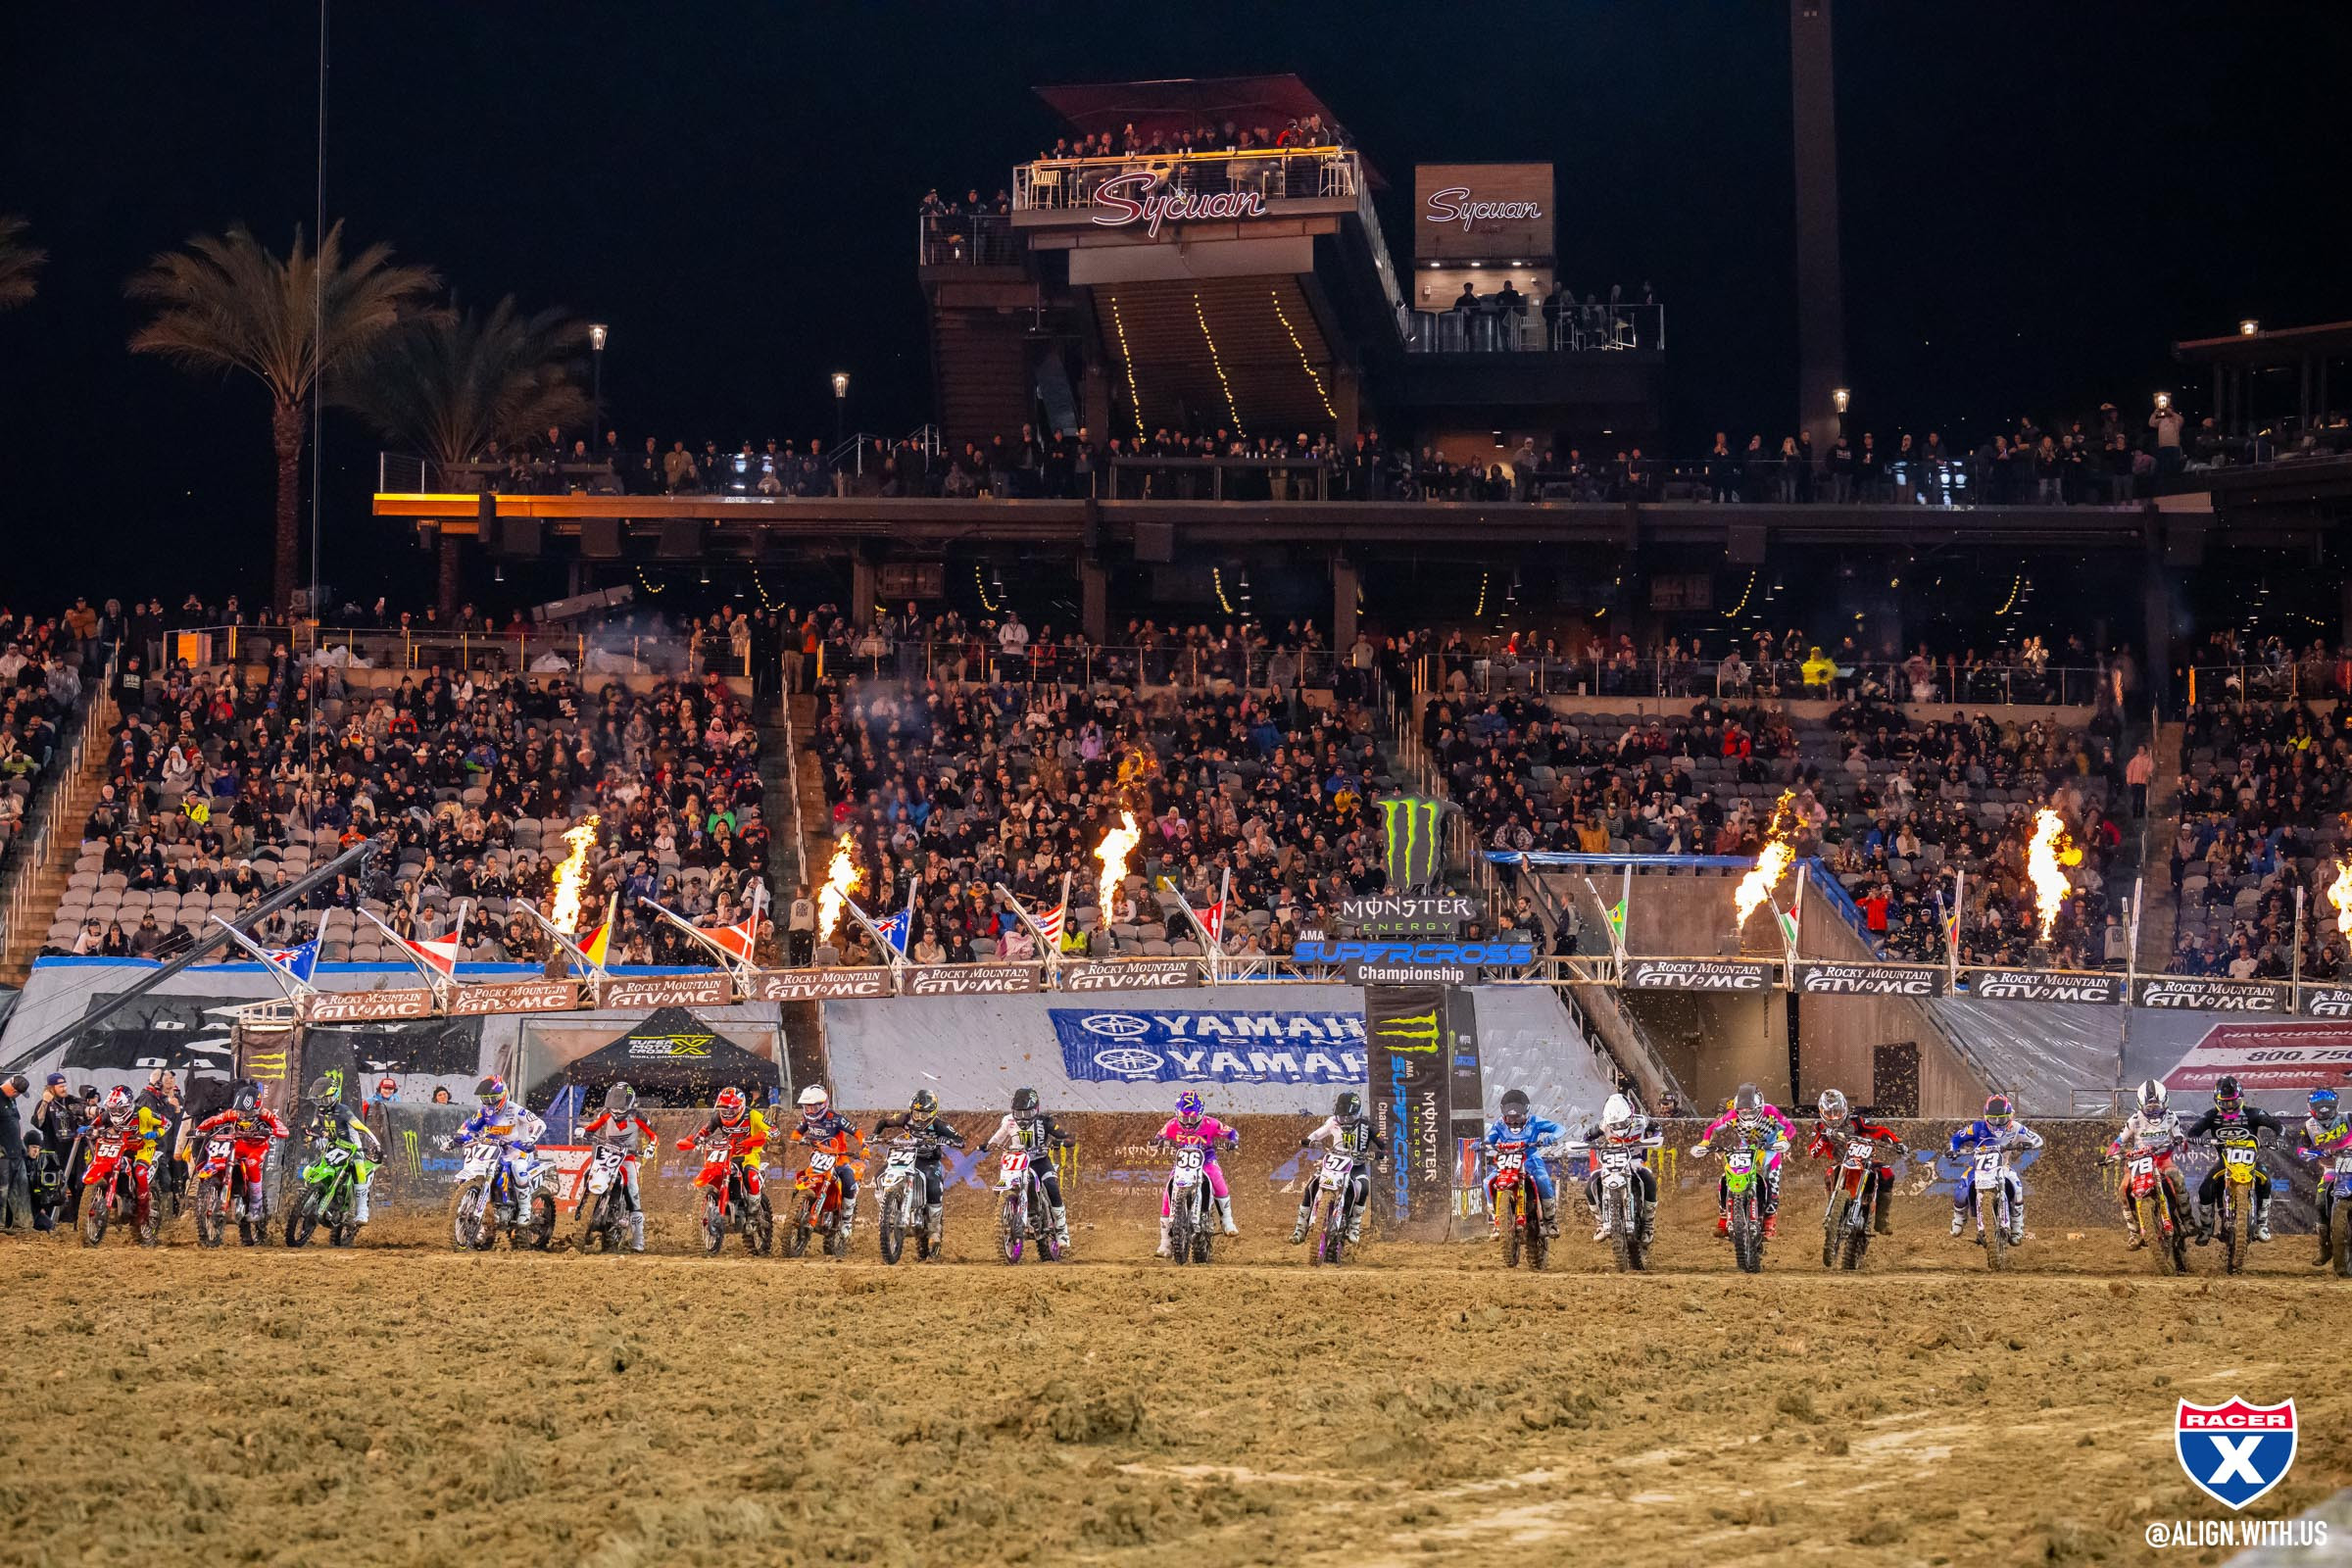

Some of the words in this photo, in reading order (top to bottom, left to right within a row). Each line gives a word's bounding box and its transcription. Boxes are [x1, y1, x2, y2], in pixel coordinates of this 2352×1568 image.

[1092, 172, 1265, 238] Sycuan
[1426, 187, 1542, 231] Sycuan
[1343, 897, 1471, 919] MONSTER
[1363, 922, 1451, 931] ENERGY
[1299, 931, 1324, 941] AMA
[1292, 942, 1537, 965] SUPERCROSS
[932, 968, 967, 979] ROCKY
[969, 967, 1029, 978] MOUNTAIN
[1088, 964, 1124, 975] ROCKY
[1126, 962, 1188, 973] MOUNTAIN
[1358, 966, 1464, 983] Championship
[1656, 961, 1694, 973] ROCKY
[1696, 962, 1762, 974] MOUNTAIN
[1826, 966, 1863, 978] ROCKY
[1866, 968, 1932, 980] MOUNTAIN
[784, 973, 819, 985] ROCKY
[821, 971, 880, 982] MOUNTAIN
[2001, 972, 2040, 984] ROCKY
[2043, 975, 2110, 988] MOUNTAIN
[2164, 981, 2205, 994] ROCKY
[2207, 983, 2276, 997] MOUNTAIN
[1153, 1015, 1366, 1037] YAMAH
[1167, 1051, 1368, 1073] YAMAH
[1405, 1059, 1414, 1078] AMA
[2183, 1071, 2327, 1082] HAWTHORNE
[1422, 1092, 1439, 1182] MONSTER
[98, 1144, 121, 1157] 55
[209, 1141, 230, 1157] 34
[325, 1148, 351, 1165] 47
[707, 1150, 728, 1162] 41
[1847, 1143, 1873, 1159] 509
[2226, 1148, 2254, 1164] 100
[599, 1148, 621, 1167] 30
[810, 1152, 835, 1171] 929
[890, 1152, 915, 1164] 24
[1003, 1153, 1026, 1170] 31
[1177, 1152, 1200, 1167] 36
[1326, 1154, 1349, 1171] 57
[1497, 1153, 1523, 1169] 245
[1601, 1153, 1628, 1168] 35
[1729, 1152, 1752, 1167] 85
[1975, 1152, 1999, 1170] 73
[2128, 1156, 2153, 1179] 78
